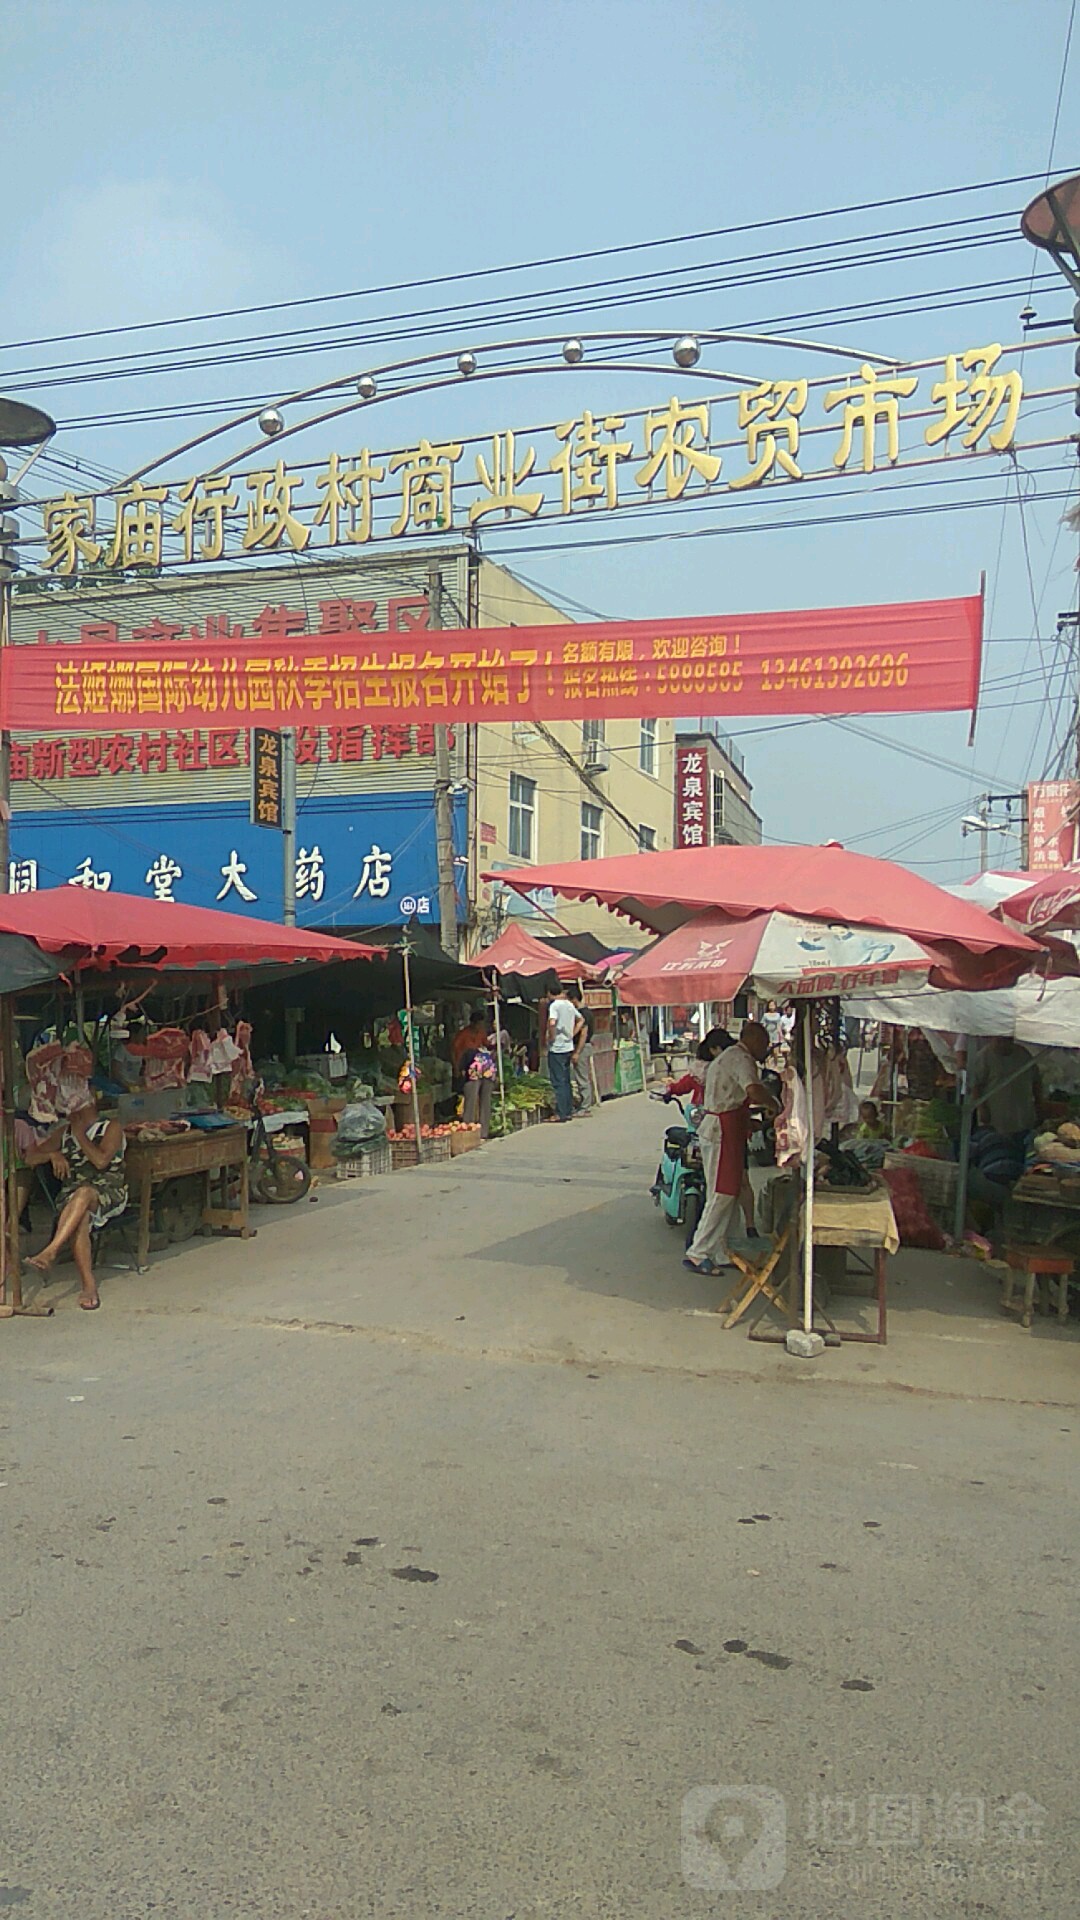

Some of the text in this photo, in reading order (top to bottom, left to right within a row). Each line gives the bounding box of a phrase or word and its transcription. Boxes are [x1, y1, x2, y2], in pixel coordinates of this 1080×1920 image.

[41, 343, 1023, 574] 家庙行政村商业街农贸市场
[257, 733, 279, 823] 龙泉宾馆
[681, 753, 704, 846] 龙泉宾馆
[8, 845, 393, 902] 同和堂大药店
